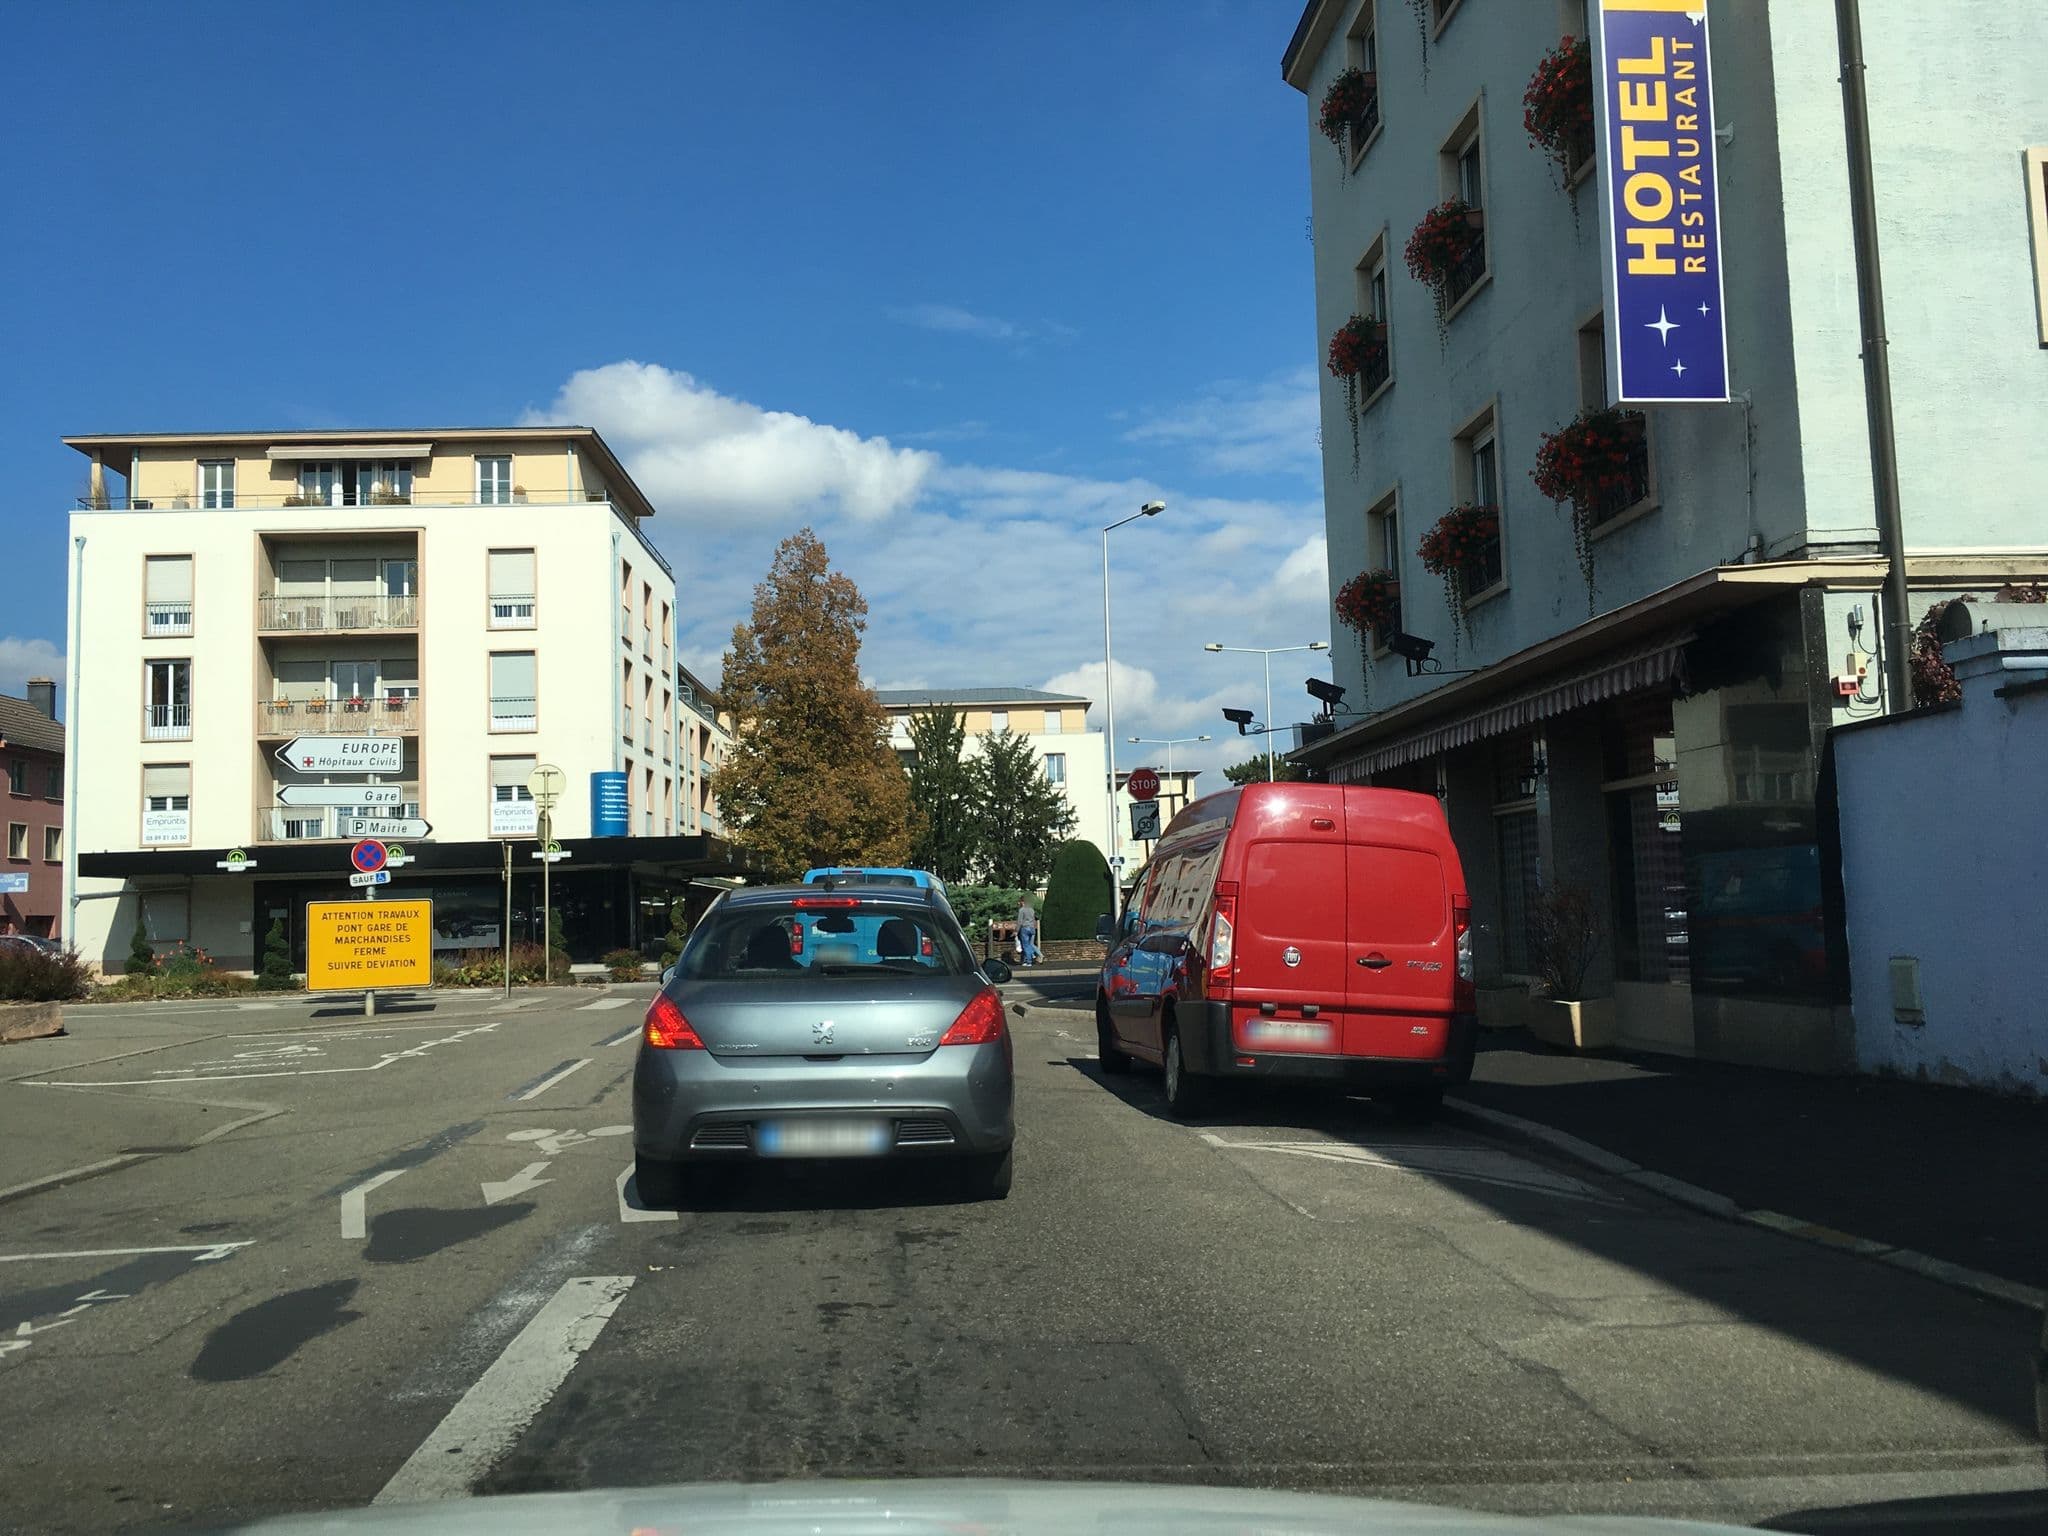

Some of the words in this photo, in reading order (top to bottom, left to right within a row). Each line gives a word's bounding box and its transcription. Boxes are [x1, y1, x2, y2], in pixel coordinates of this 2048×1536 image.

[1617, 36, 1677, 276] HOTEL
[1671, 36, 1707, 274] RESTAURANT
[341, 743, 398, 754] EUROPE
[318, 757, 363, 768] Hôpitaux
[369, 757, 397, 766] Civils
[1130, 780, 1157, 791] STOP
[365, 790, 397, 801] Gare
[354, 821, 364, 833] P
[368, 821, 408, 833] Mairie
[1141, 820, 1152, 829] 30
[352, 873, 375, 885] SAUF
[321, 911, 374, 920] ATTENTION
[378, 910, 420, 919] TRAVAUX
[337, 924, 363, 933] PONT
[367, 923, 392, 932] GARE
[396, 922, 408, 931] DE
[334, 934, 411, 944] MARCHANDISES
[354, 946, 387, 956] FERME
[327, 961, 363, 970] SUIVRE
[366, 959, 416, 969] DEVIATION
